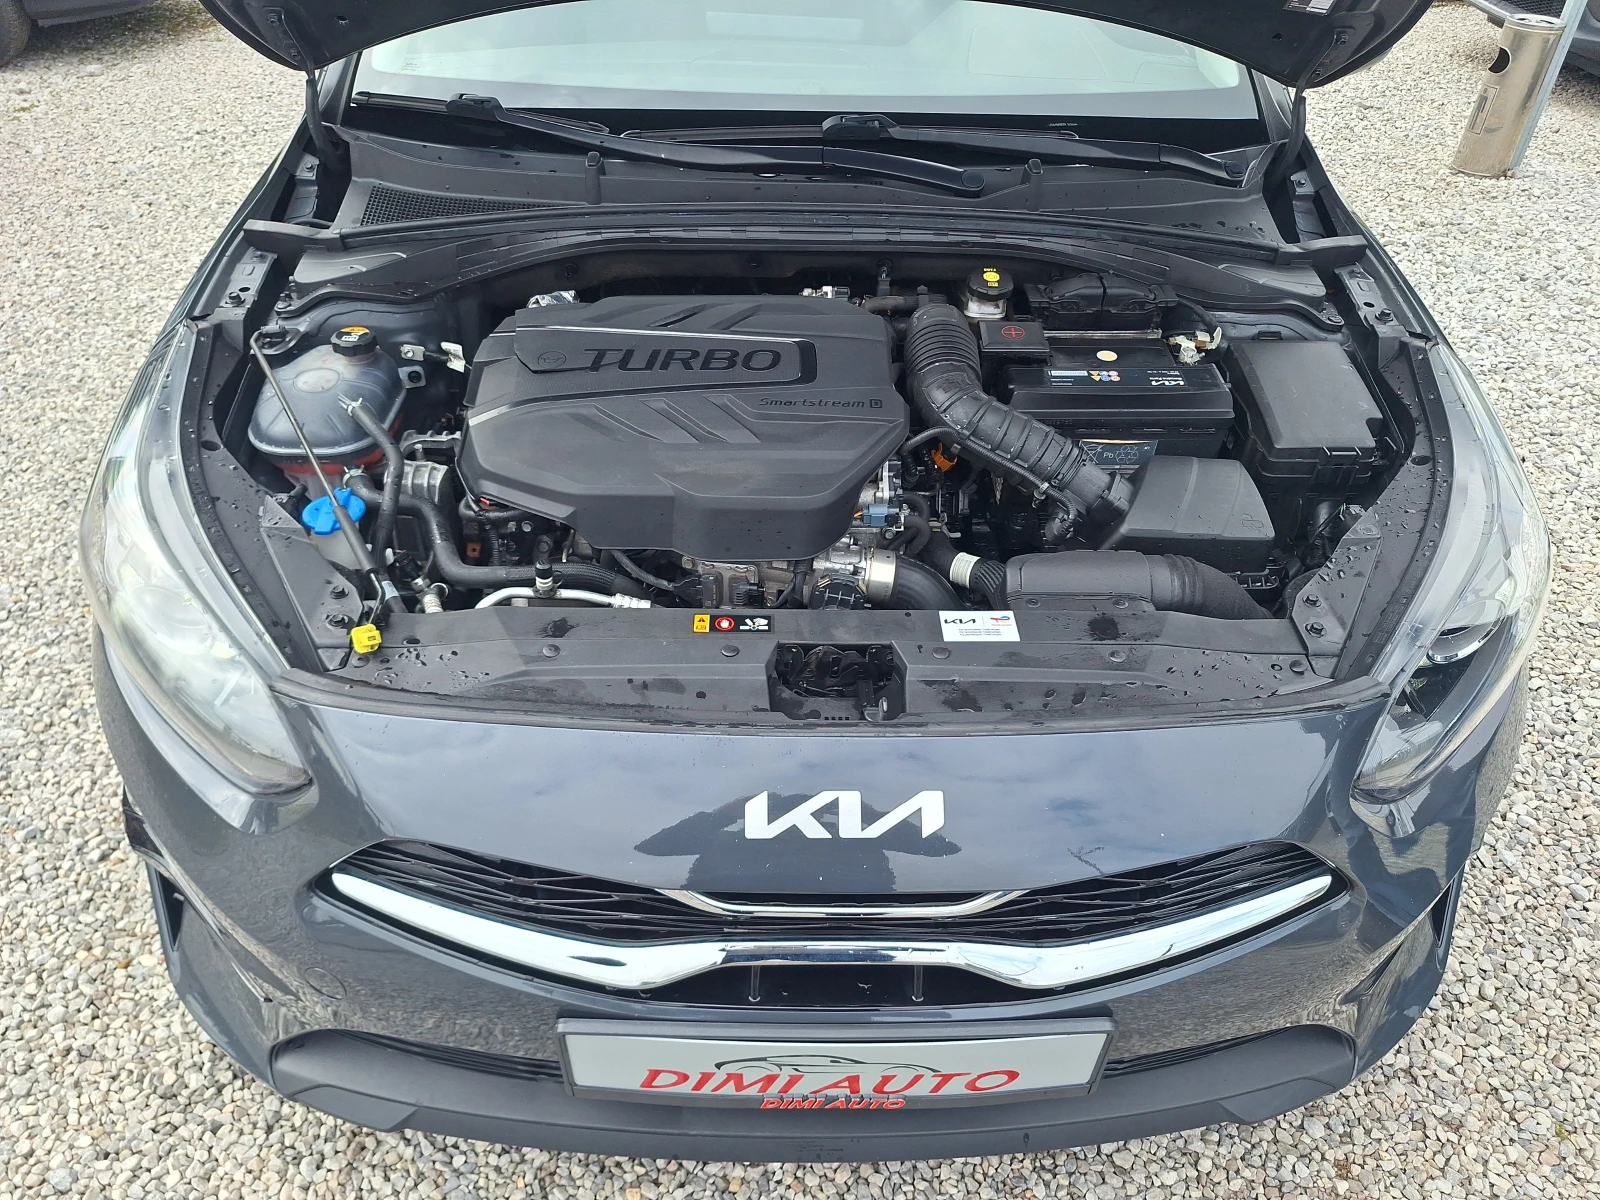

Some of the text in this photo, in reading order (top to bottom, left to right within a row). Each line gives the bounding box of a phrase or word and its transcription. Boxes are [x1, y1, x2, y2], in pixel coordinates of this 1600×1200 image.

[583, 348, 782, 373] TURBO
[759, 397, 865, 408] Smartstream
[1103, 451, 1114, 459] Pb
[744, 790, 945, 839] KIA
[639, 1068, 1021, 1095] DIMI AUTO
[760, 1097, 906, 1110] DIMI AUTO
